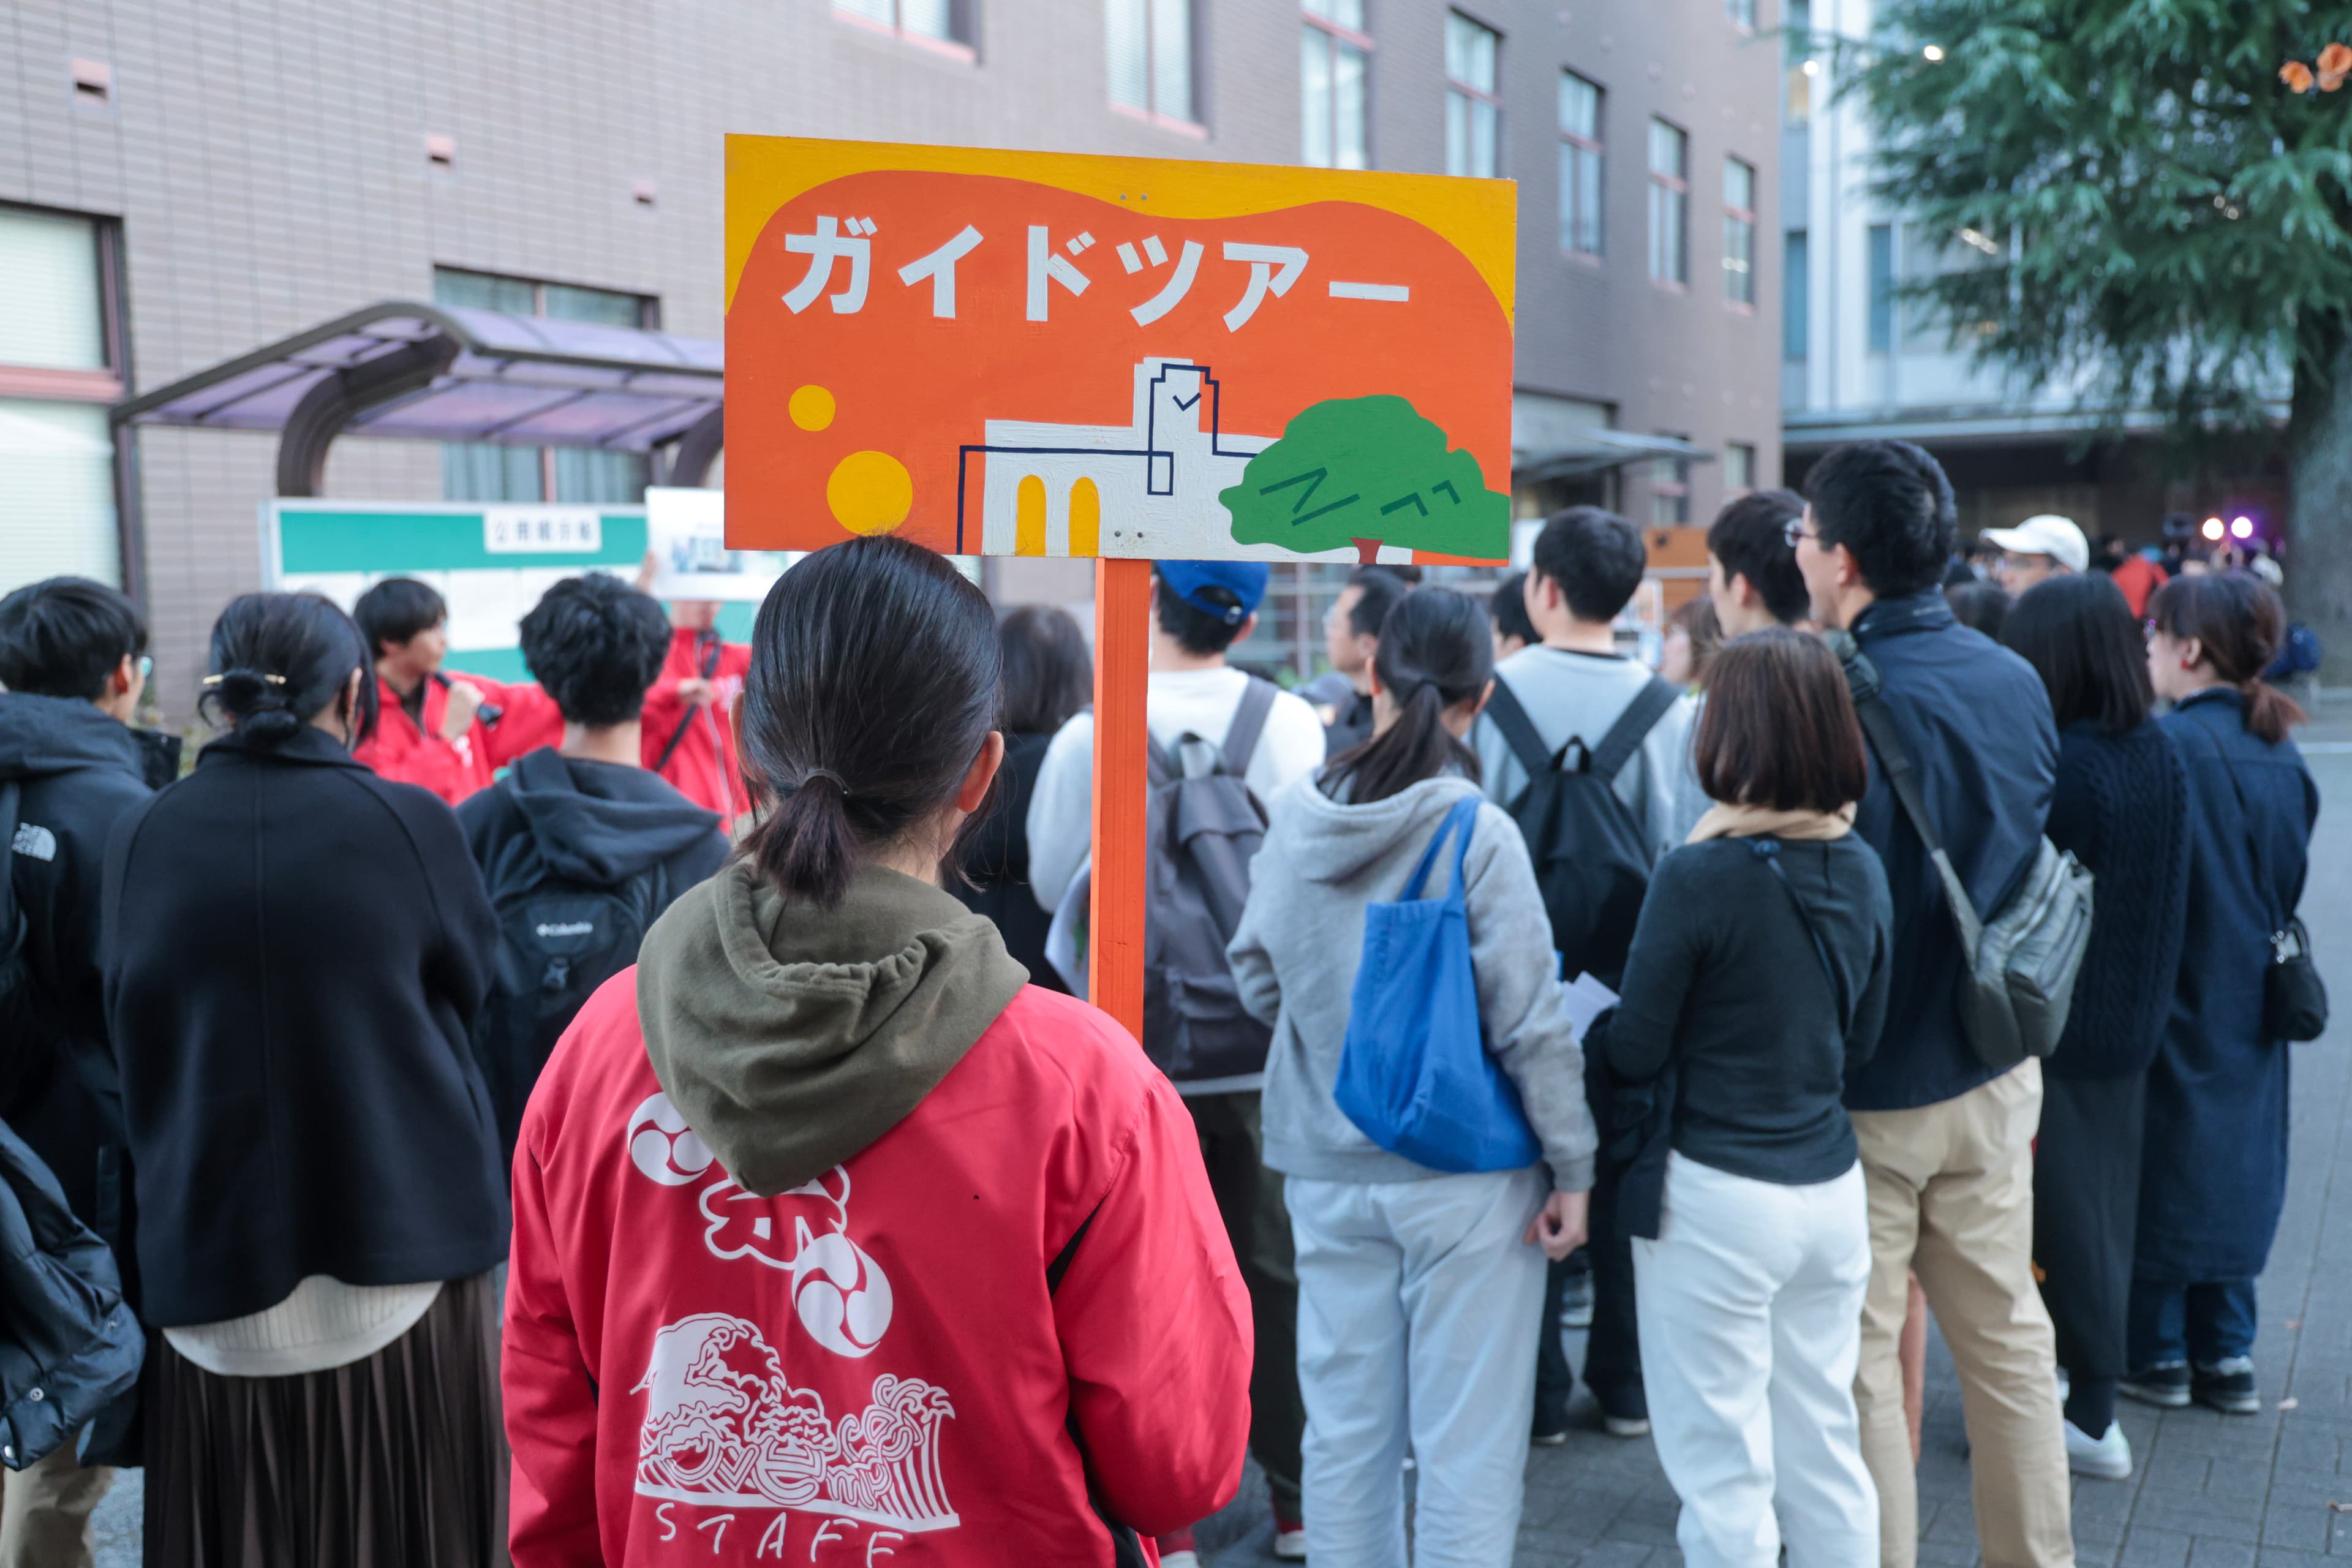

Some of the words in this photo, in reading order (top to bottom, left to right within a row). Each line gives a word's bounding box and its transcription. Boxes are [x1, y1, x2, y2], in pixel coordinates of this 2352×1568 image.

[782, 215, 1409, 333] ガイドツアー
[656, 1502, 904, 1568] STAFF
